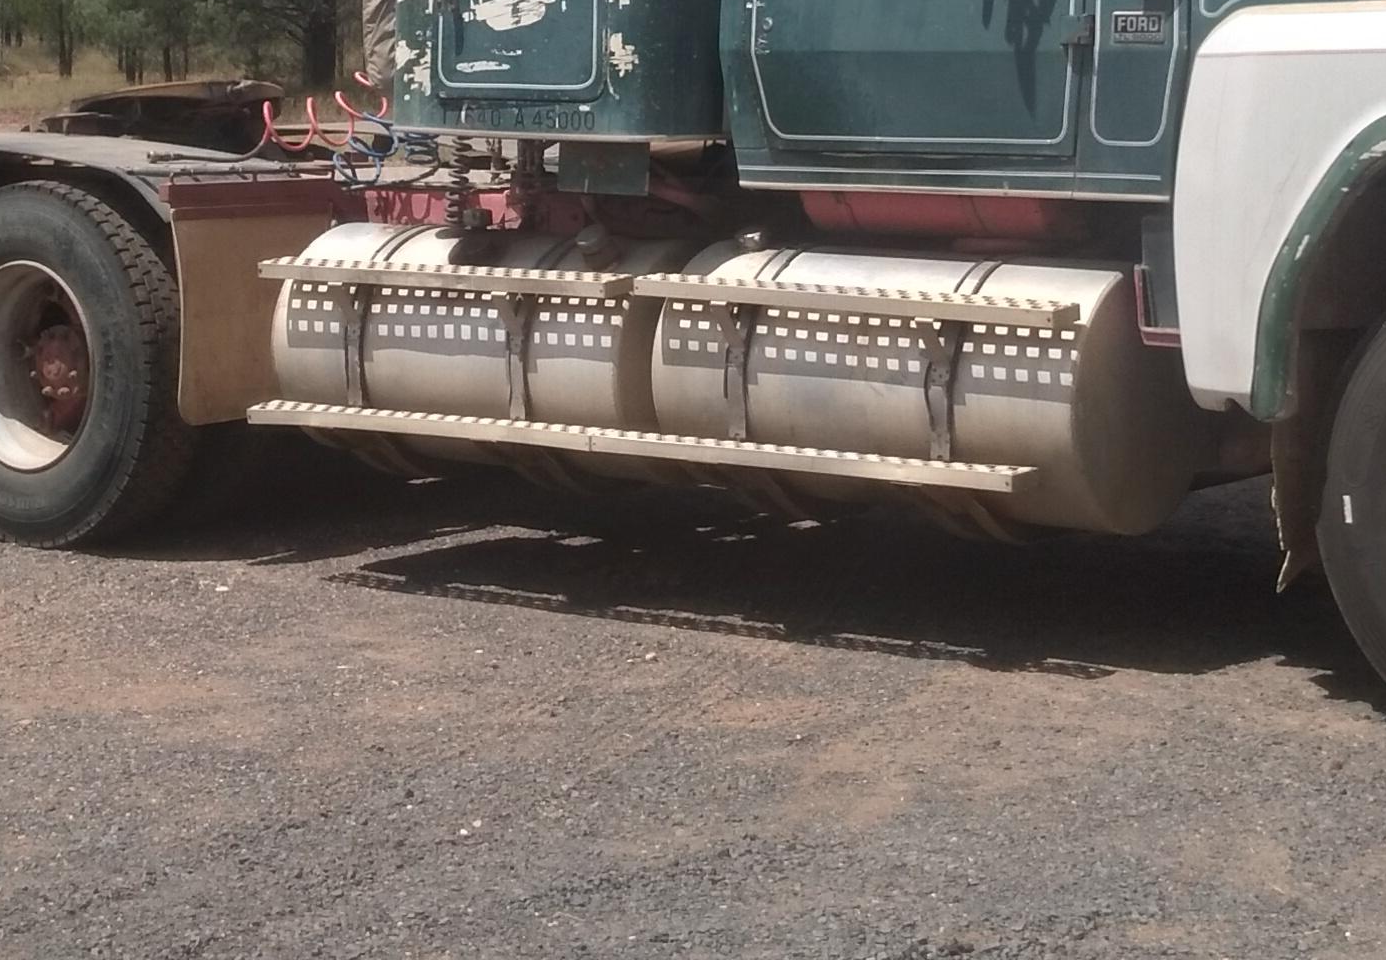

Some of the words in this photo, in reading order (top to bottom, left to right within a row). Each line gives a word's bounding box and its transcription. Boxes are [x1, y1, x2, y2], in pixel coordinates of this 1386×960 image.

[1116, 16, 1160, 31] FORD
[514, 106, 525, 129] A
[532, 109, 596, 131] 45000
